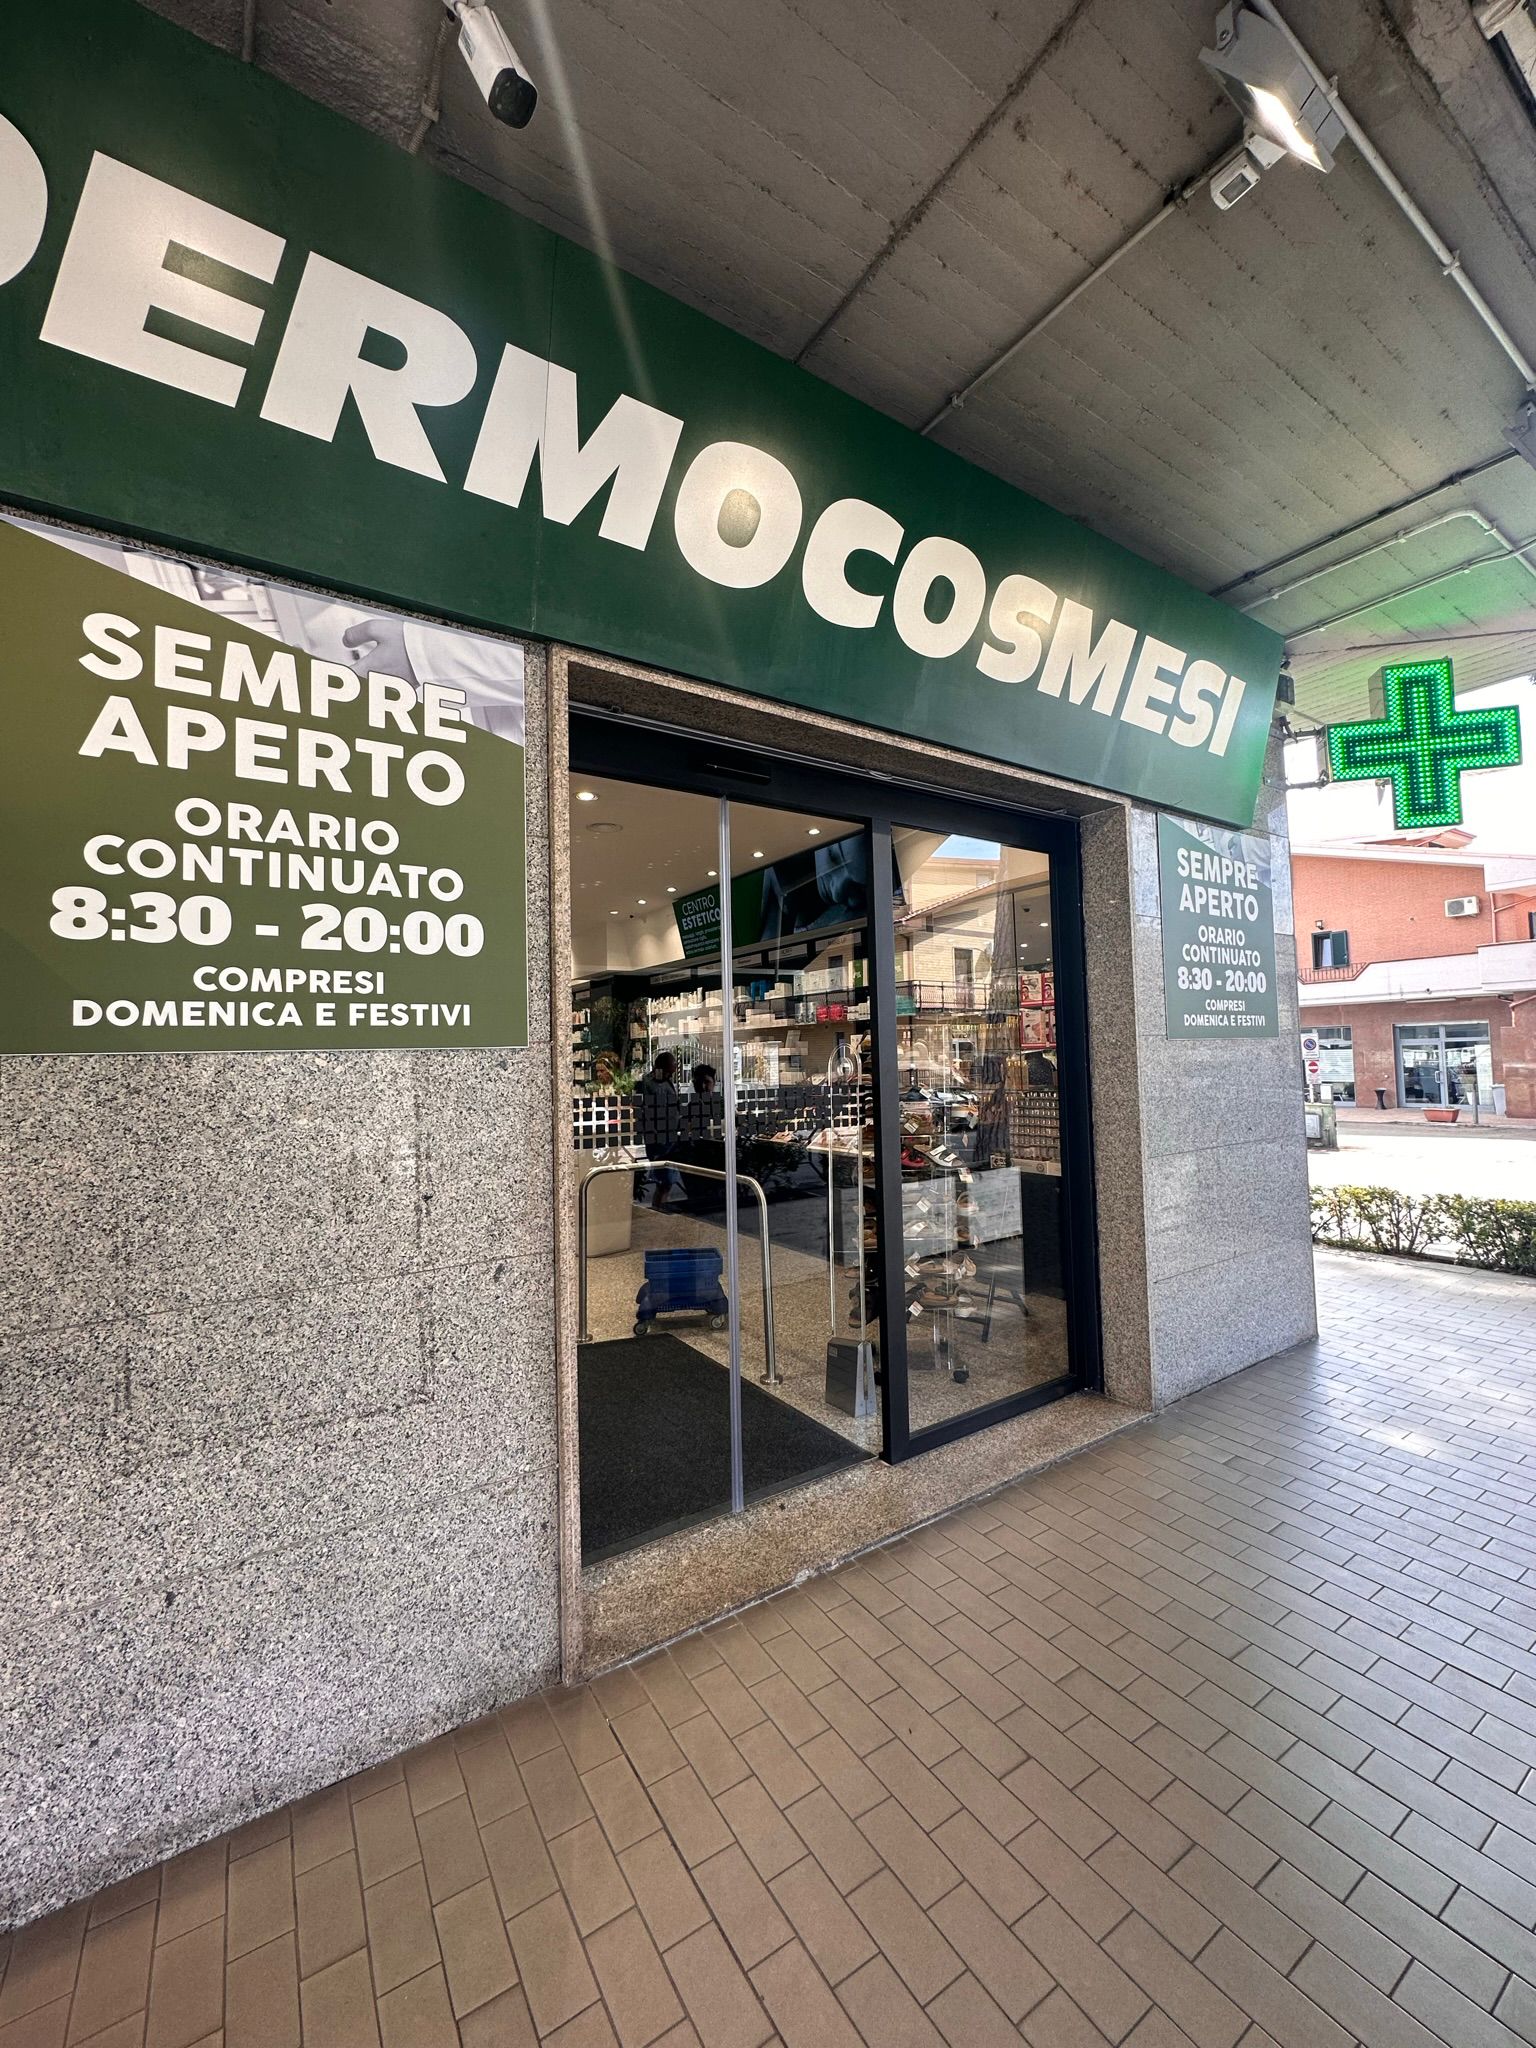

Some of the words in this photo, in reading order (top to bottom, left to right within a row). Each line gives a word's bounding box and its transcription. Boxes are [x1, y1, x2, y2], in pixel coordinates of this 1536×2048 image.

[0, 112, 1247, 758] ERMOCOSMESI
[78, 612, 468, 744] SEMPRE
[78, 695, 466, 807] APERTO
[174, 797, 400, 856] ORARIO
[83, 834, 464, 902] CONTINUATO
[1177, 847, 1259, 891] SEMPRE
[682, 894, 715, 916] CENTRO
[1178, 882, 1259, 922] APERTO
[49, 886, 232, 946] 8:30
[255, 924, 279, 937] -
[300, 903, 485, 958] 20:00
[682, 907, 721, 931] ESTETICO
[1198, 924, 1246, 947] ORARIO
[1182, 943, 1261, 968] CONTINUATO
[192, 965, 384, 995] COMPRESI
[1177, 965, 1213, 991] 8:30
[1225, 969, 1267, 994] 20:00
[72, 999, 304, 1027] DOMENICA
[315, 1002, 337, 1027] E
[349, 1002, 471, 1027] FESTIVI
[1183, 1013, 1229, 1027] DOMENICA
[1230, 1014, 1237, 1027] E
[1237, 1014, 1266, 1027] FESTIVI
[1205, 998, 1246, 1012] COMPRESI
